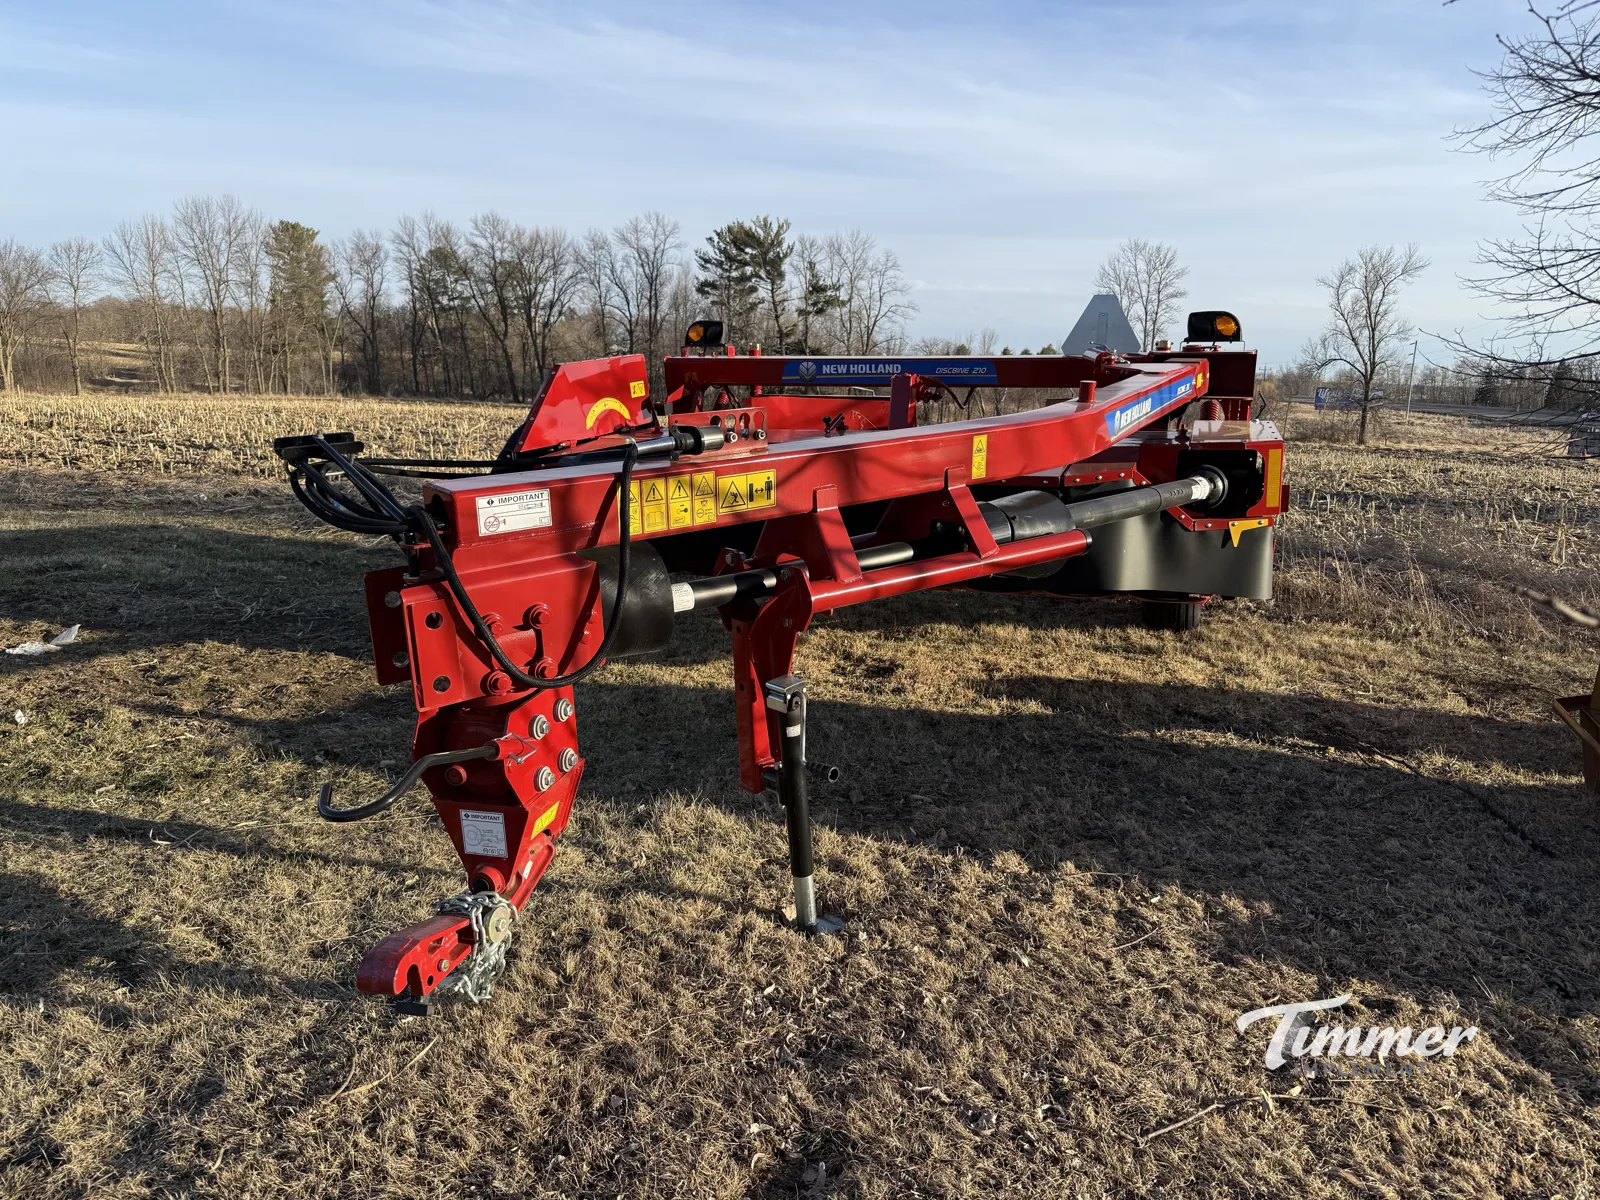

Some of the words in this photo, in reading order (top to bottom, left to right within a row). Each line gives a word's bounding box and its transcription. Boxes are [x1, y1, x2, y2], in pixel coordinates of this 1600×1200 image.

[822, 364, 848, 374] NEW
[850, 363, 902, 374] HOLLAND
[498, 492, 545, 504] IMPORTANT
[470, 813, 501, 821] IMPORTANT
